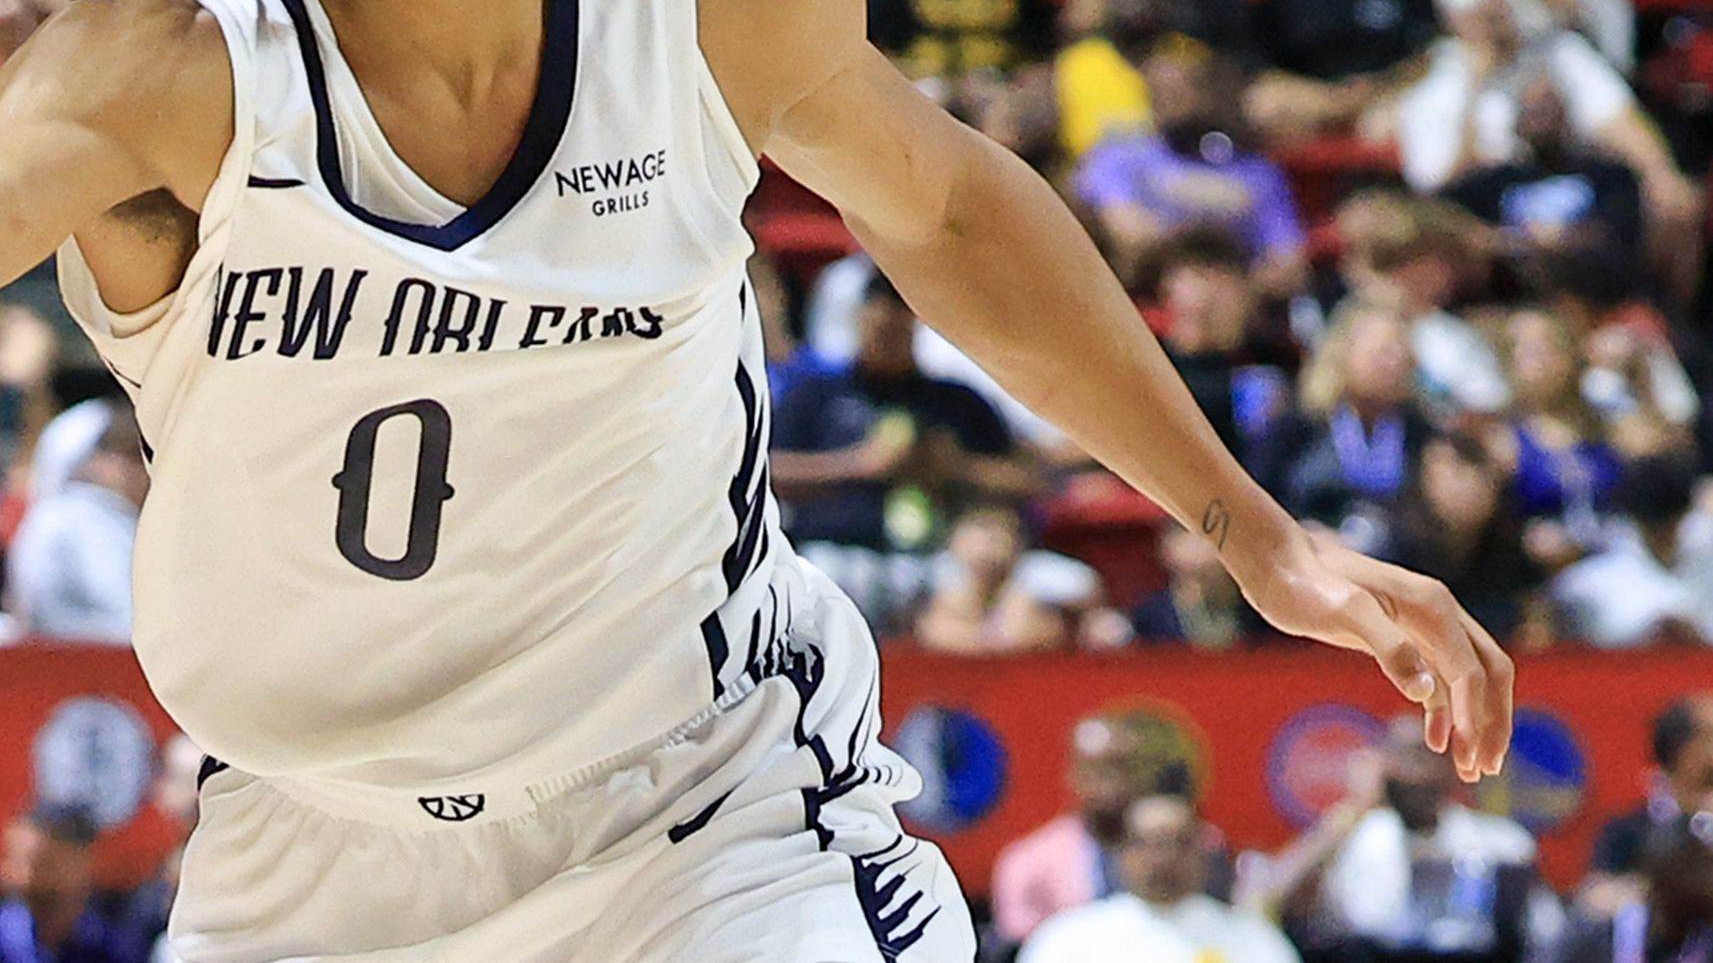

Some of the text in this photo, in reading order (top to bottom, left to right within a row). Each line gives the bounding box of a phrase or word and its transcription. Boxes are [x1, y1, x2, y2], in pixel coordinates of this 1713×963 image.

[554, 149, 666, 197] NEWAGE
[592, 191, 649, 216] GRILLS
[331, 398, 455, 581] 0
